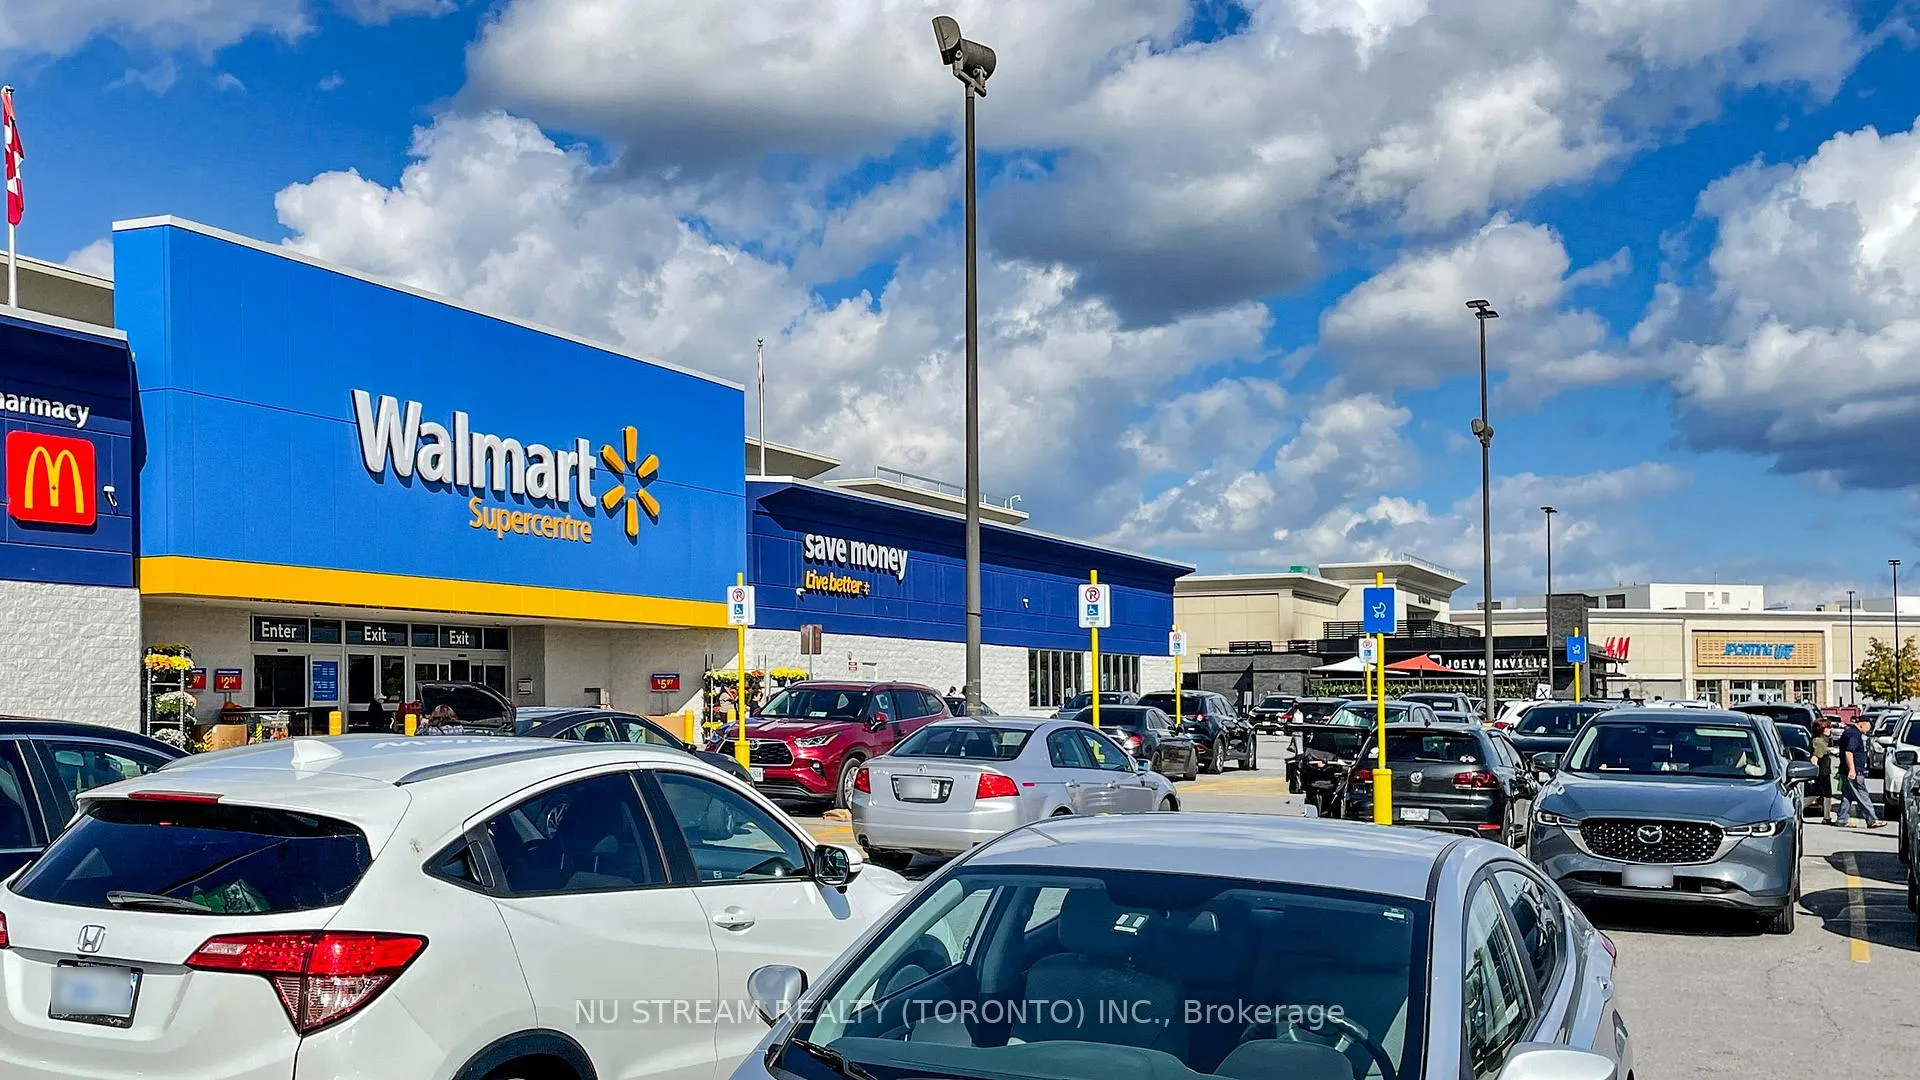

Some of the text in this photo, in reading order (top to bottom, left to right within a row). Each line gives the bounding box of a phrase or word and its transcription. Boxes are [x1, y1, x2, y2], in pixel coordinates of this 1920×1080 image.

[351, 389, 596, 507] Walmart
[469, 496, 592, 543] Supercentre
[805, 534, 908, 581] save money
[805, 570, 862, 594] Live better
[261, 621, 297, 638] Enter
[364, 626, 387, 642] Exit
[449, 630, 470, 645] Exit
[1446, 658, 1548, 669] JOEY MRKVILLE
